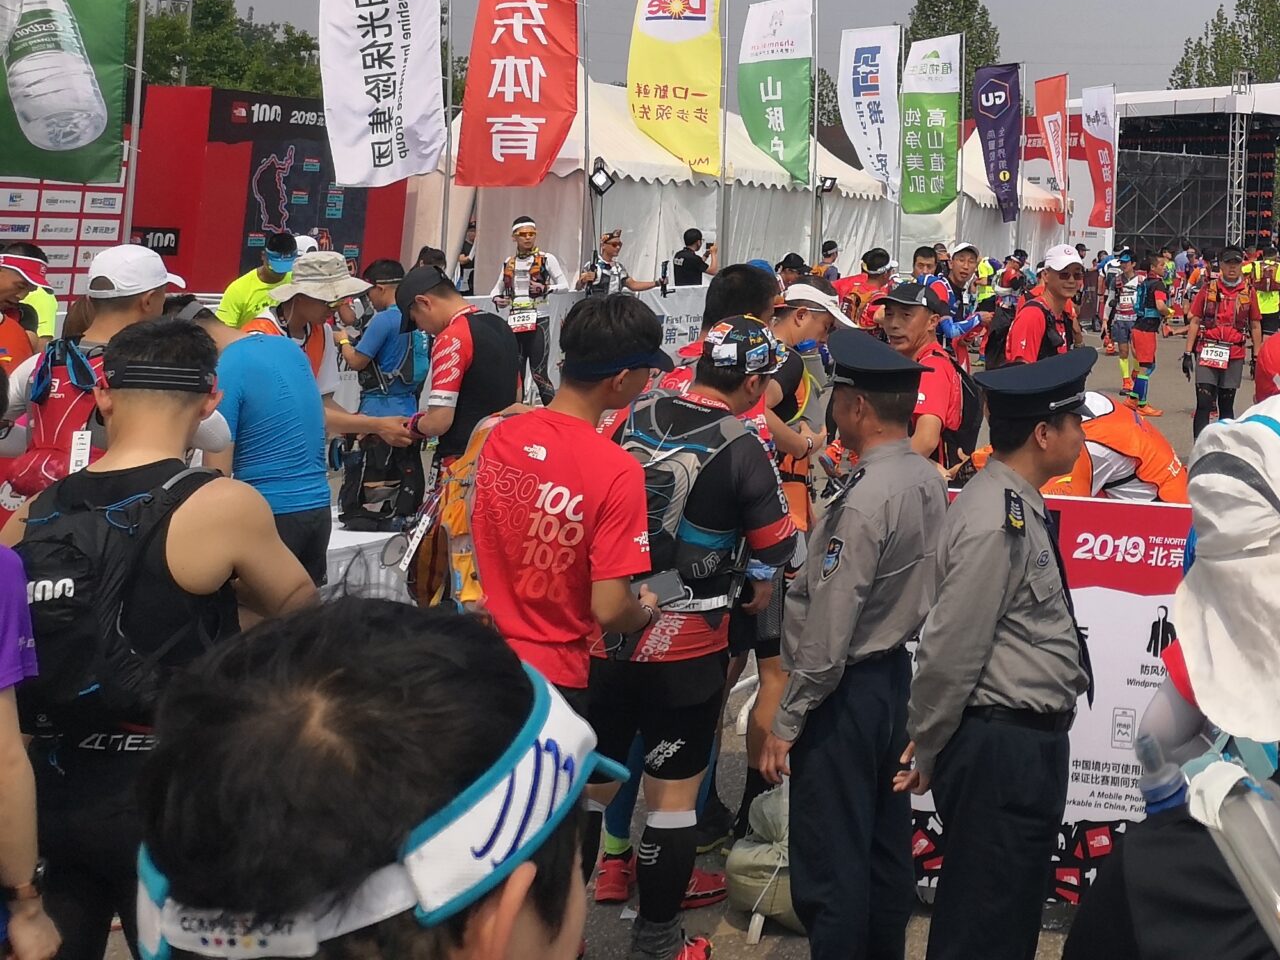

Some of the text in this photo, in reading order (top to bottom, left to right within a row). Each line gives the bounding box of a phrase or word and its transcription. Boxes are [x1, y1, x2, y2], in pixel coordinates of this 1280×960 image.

[251, 102, 318, 126] 100 2019
[1205, 349, 1224, 358] 1750
[1148, 535, 1163, 545] THE
[1072, 532, 1146, 564] 2019
[1147, 546, 1185, 568] 北京
[1089, 790, 1095, 798] A
[1097, 791, 1123, 801] Mobile
[1094, 800, 1102, 809] in
